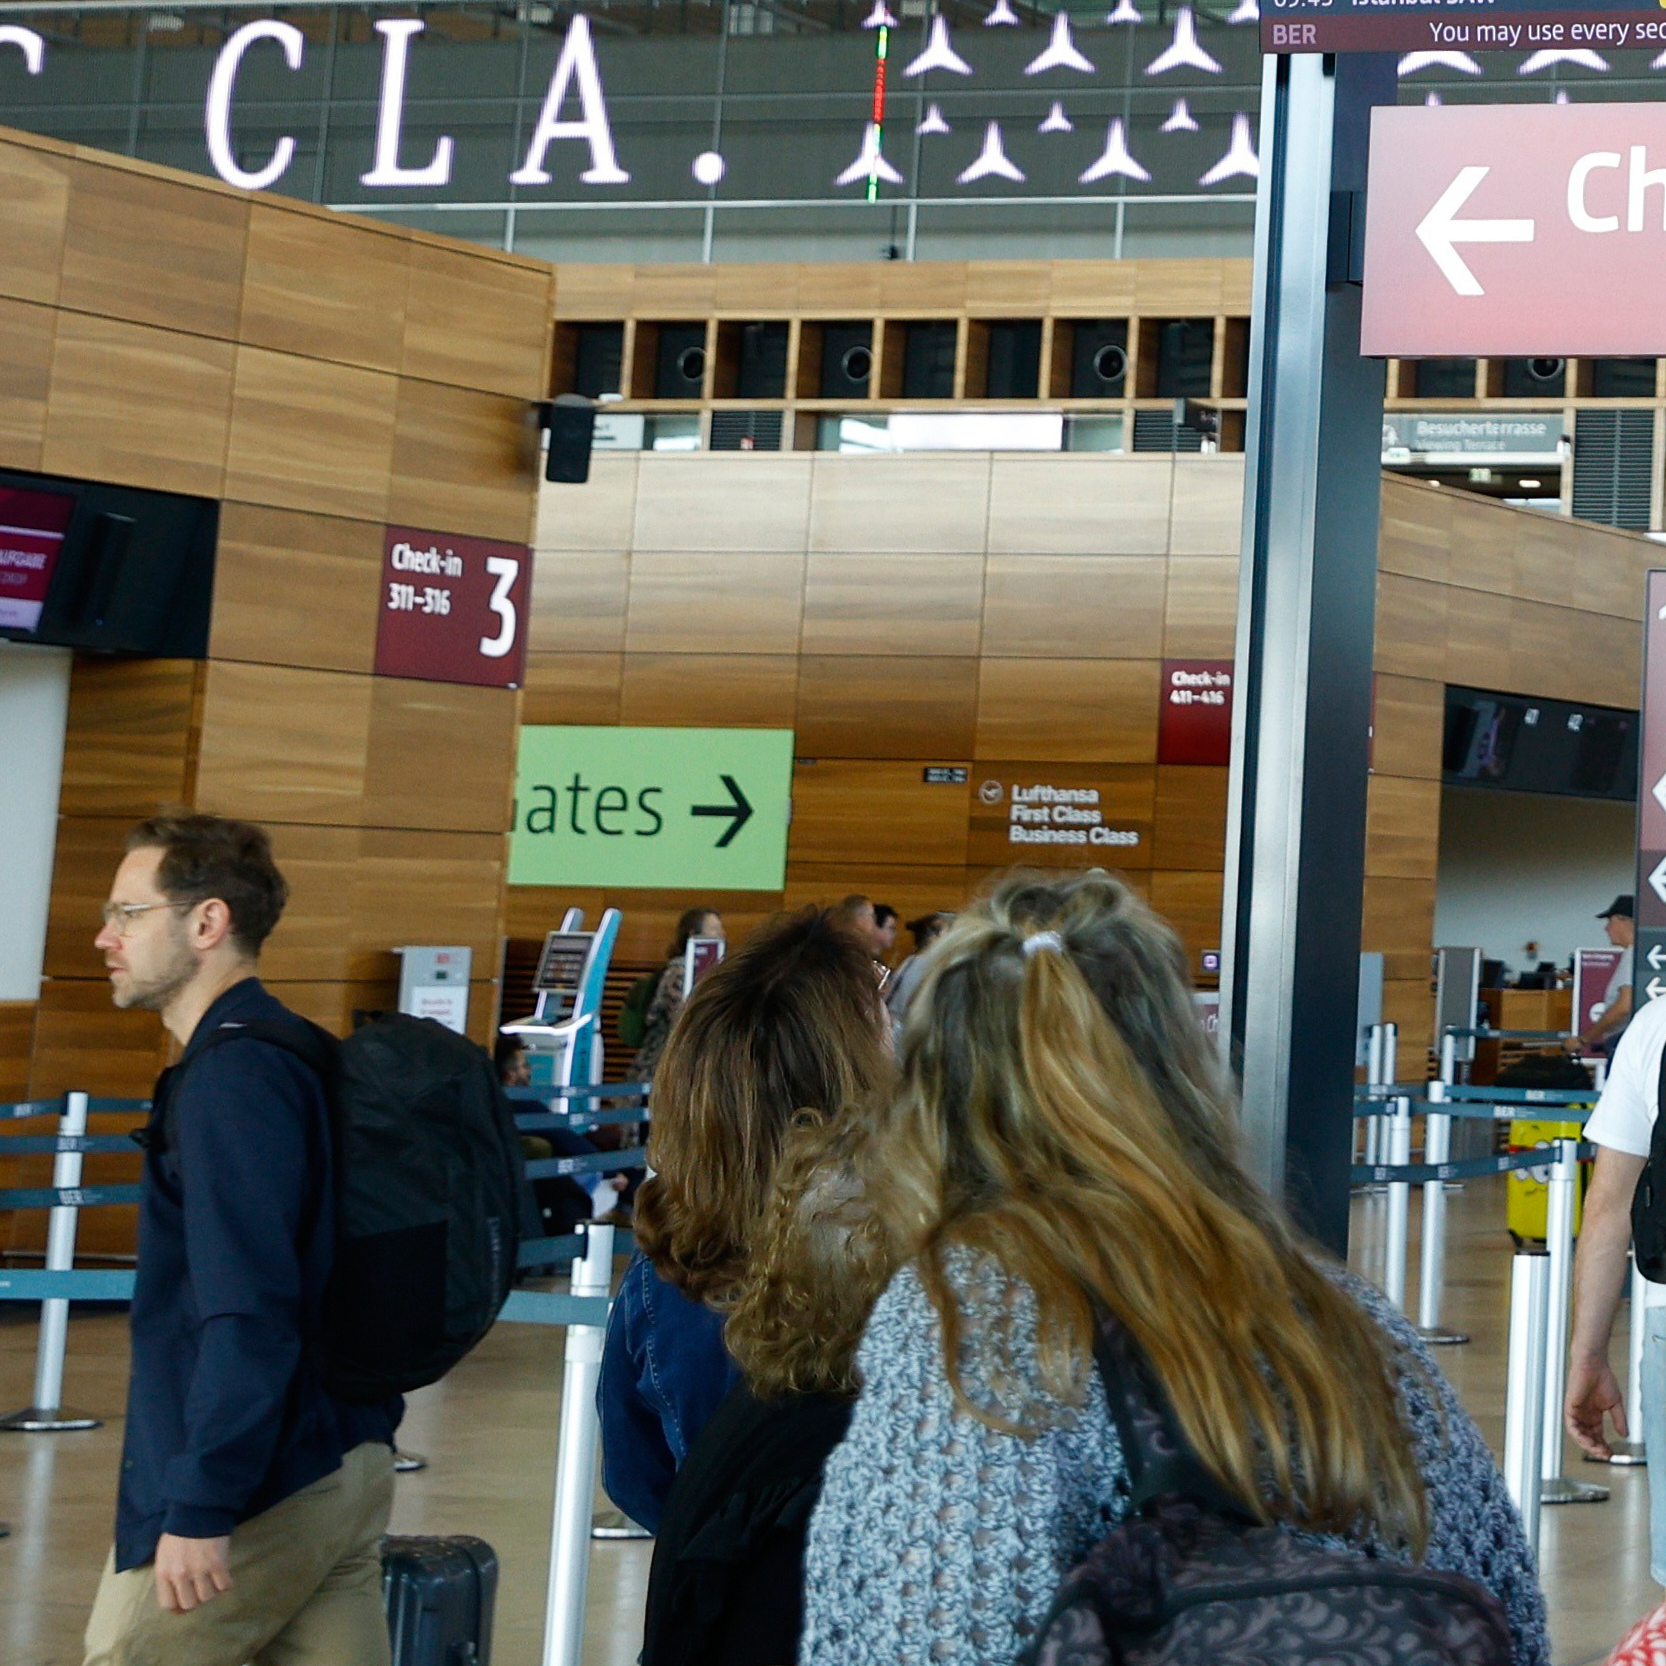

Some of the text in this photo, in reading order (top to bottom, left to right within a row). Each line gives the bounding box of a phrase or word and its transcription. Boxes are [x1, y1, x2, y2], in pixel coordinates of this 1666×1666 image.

[1274, 24, 1316, 44] BER
[1429, 22, 1482, 43] You
[1488, 24, 1522, 46] may
[1529, 24, 1563, 40] use
[1571, 24, 1629, 45] every
[391, 543, 519, 658] Check-in 3
[1171, 671, 1230, 687] Check-in
[1011, 785, 1099, 804] Lufthansa
[511, 773, 664, 838] ates
[1010, 805, 1102, 825] First Class
[1009, 825, 1139, 846] Business Class
